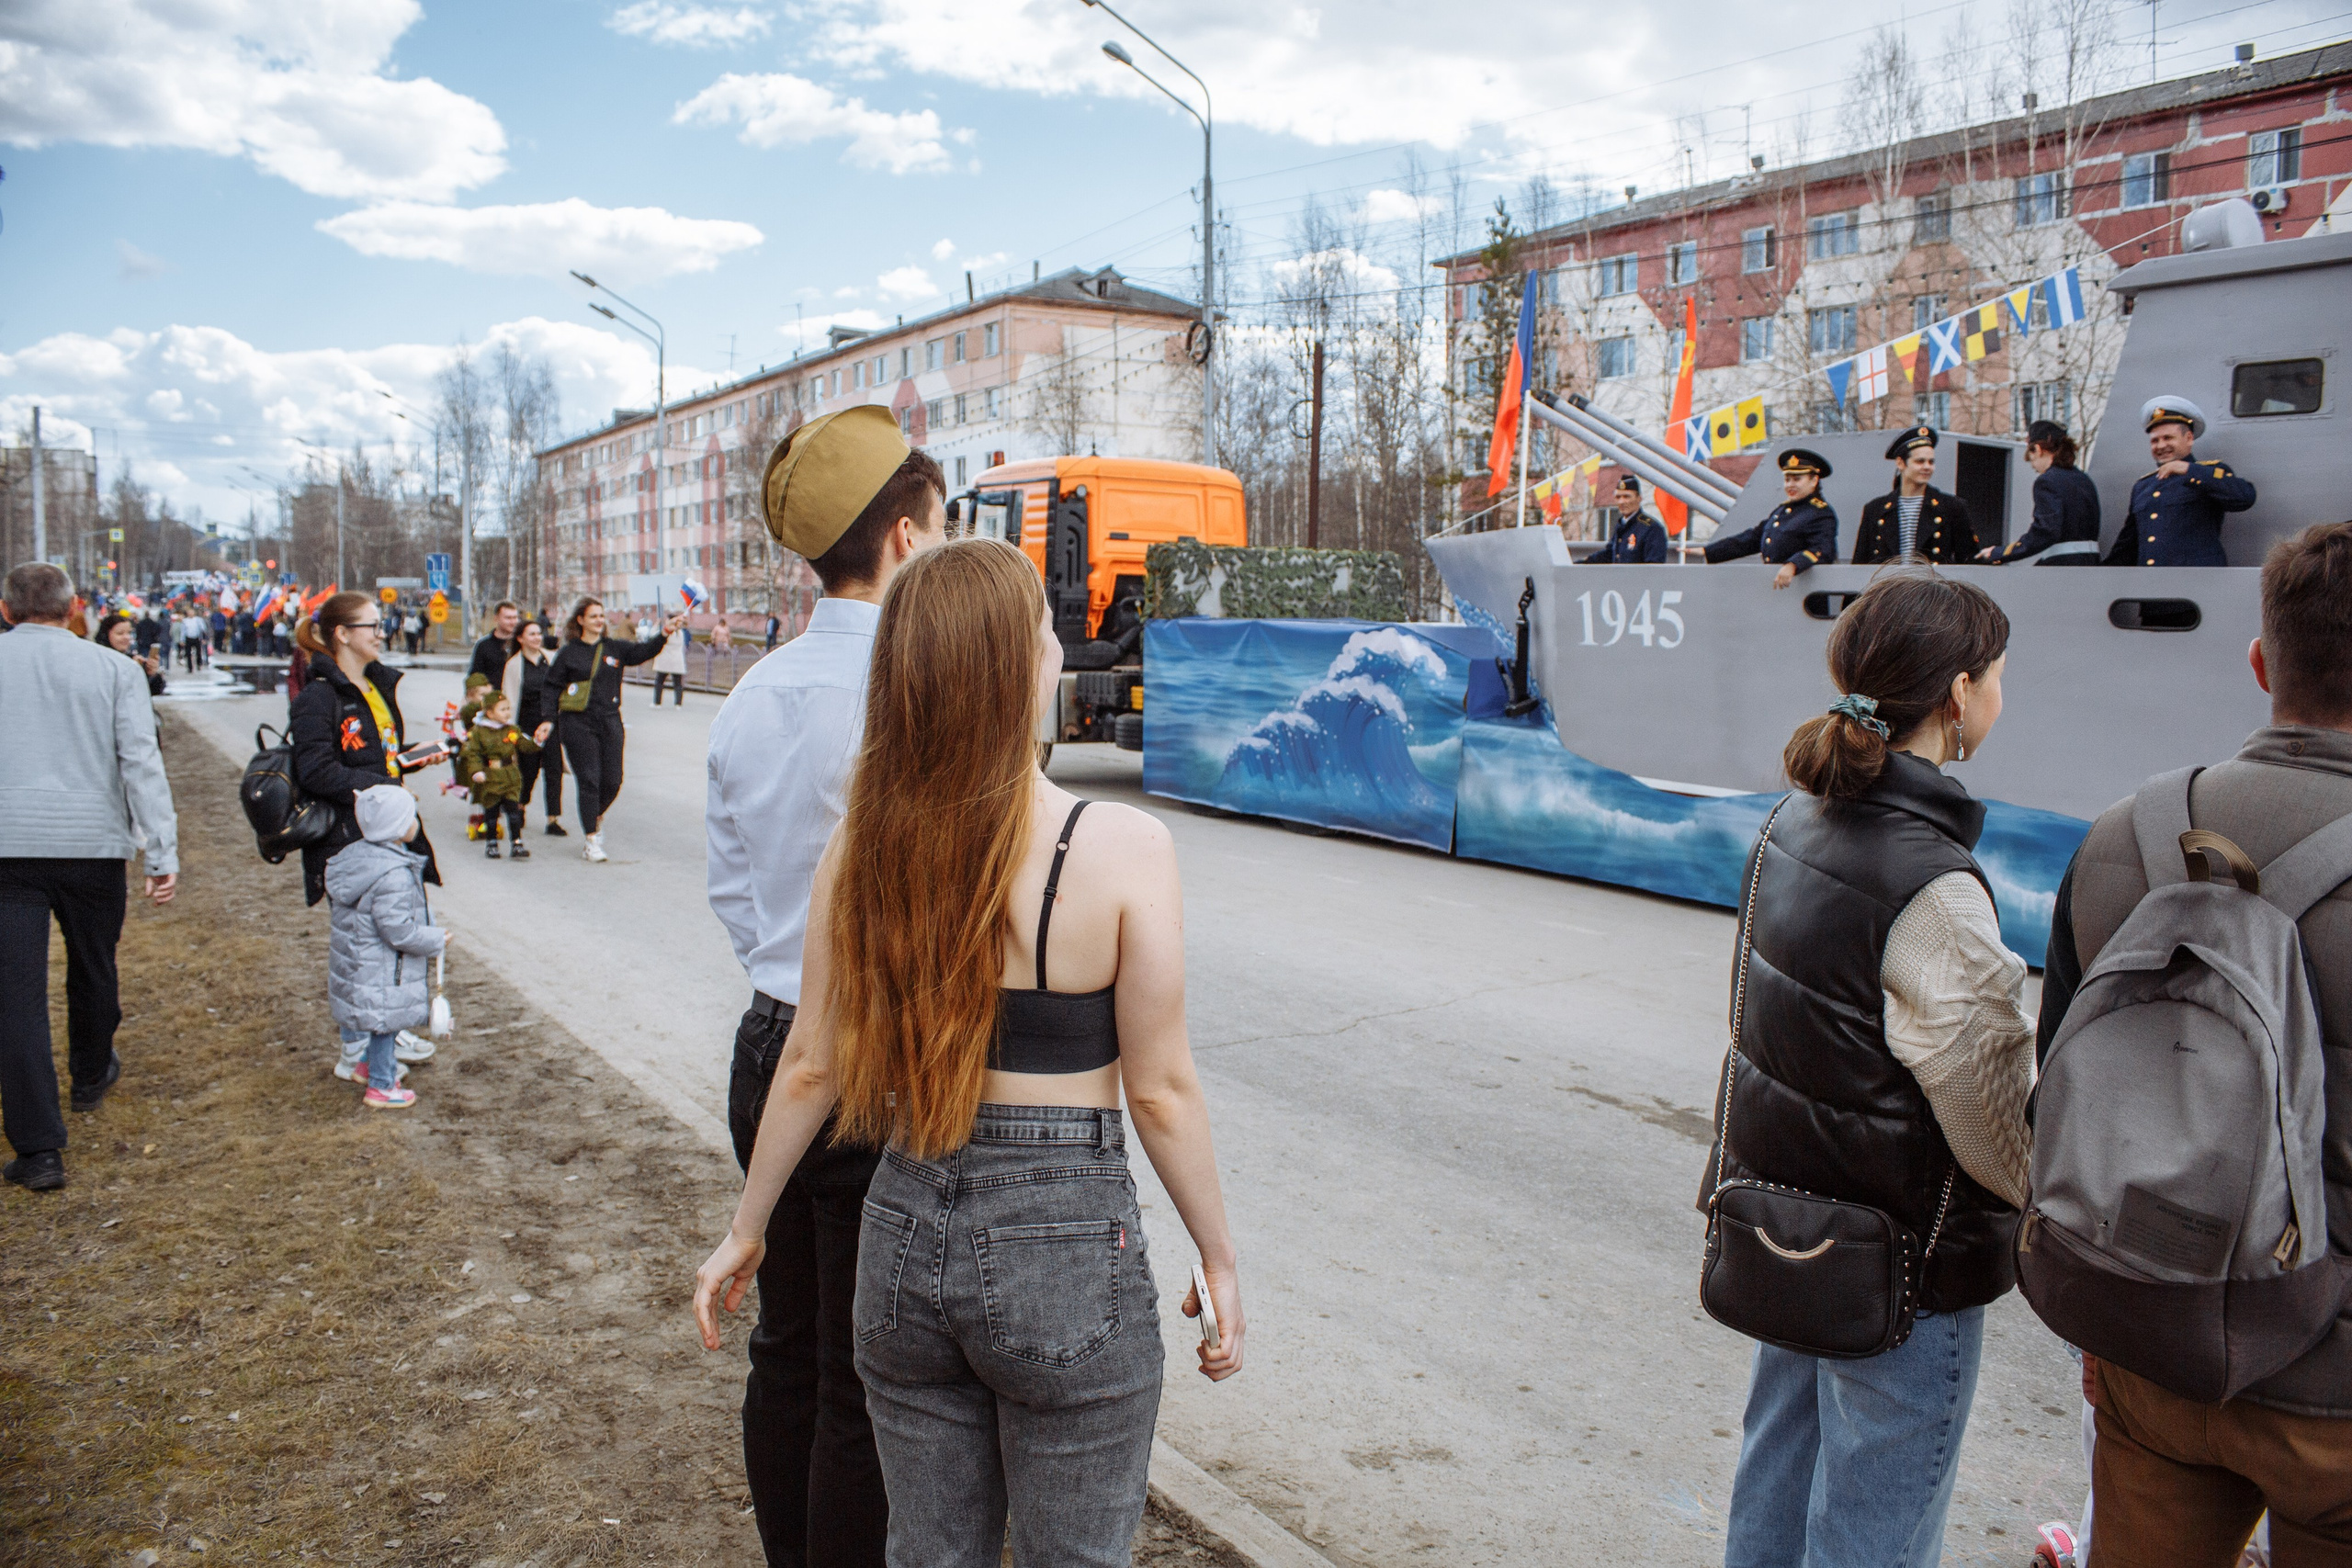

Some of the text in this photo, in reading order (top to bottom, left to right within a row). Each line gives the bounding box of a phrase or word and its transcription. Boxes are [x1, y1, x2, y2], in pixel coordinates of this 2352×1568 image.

[1576, 589, 1685, 649] 1945
[2156, 1204, 2193, 1223] ADVENTURE
[2181, 1223, 2202, 1234] SINCE
